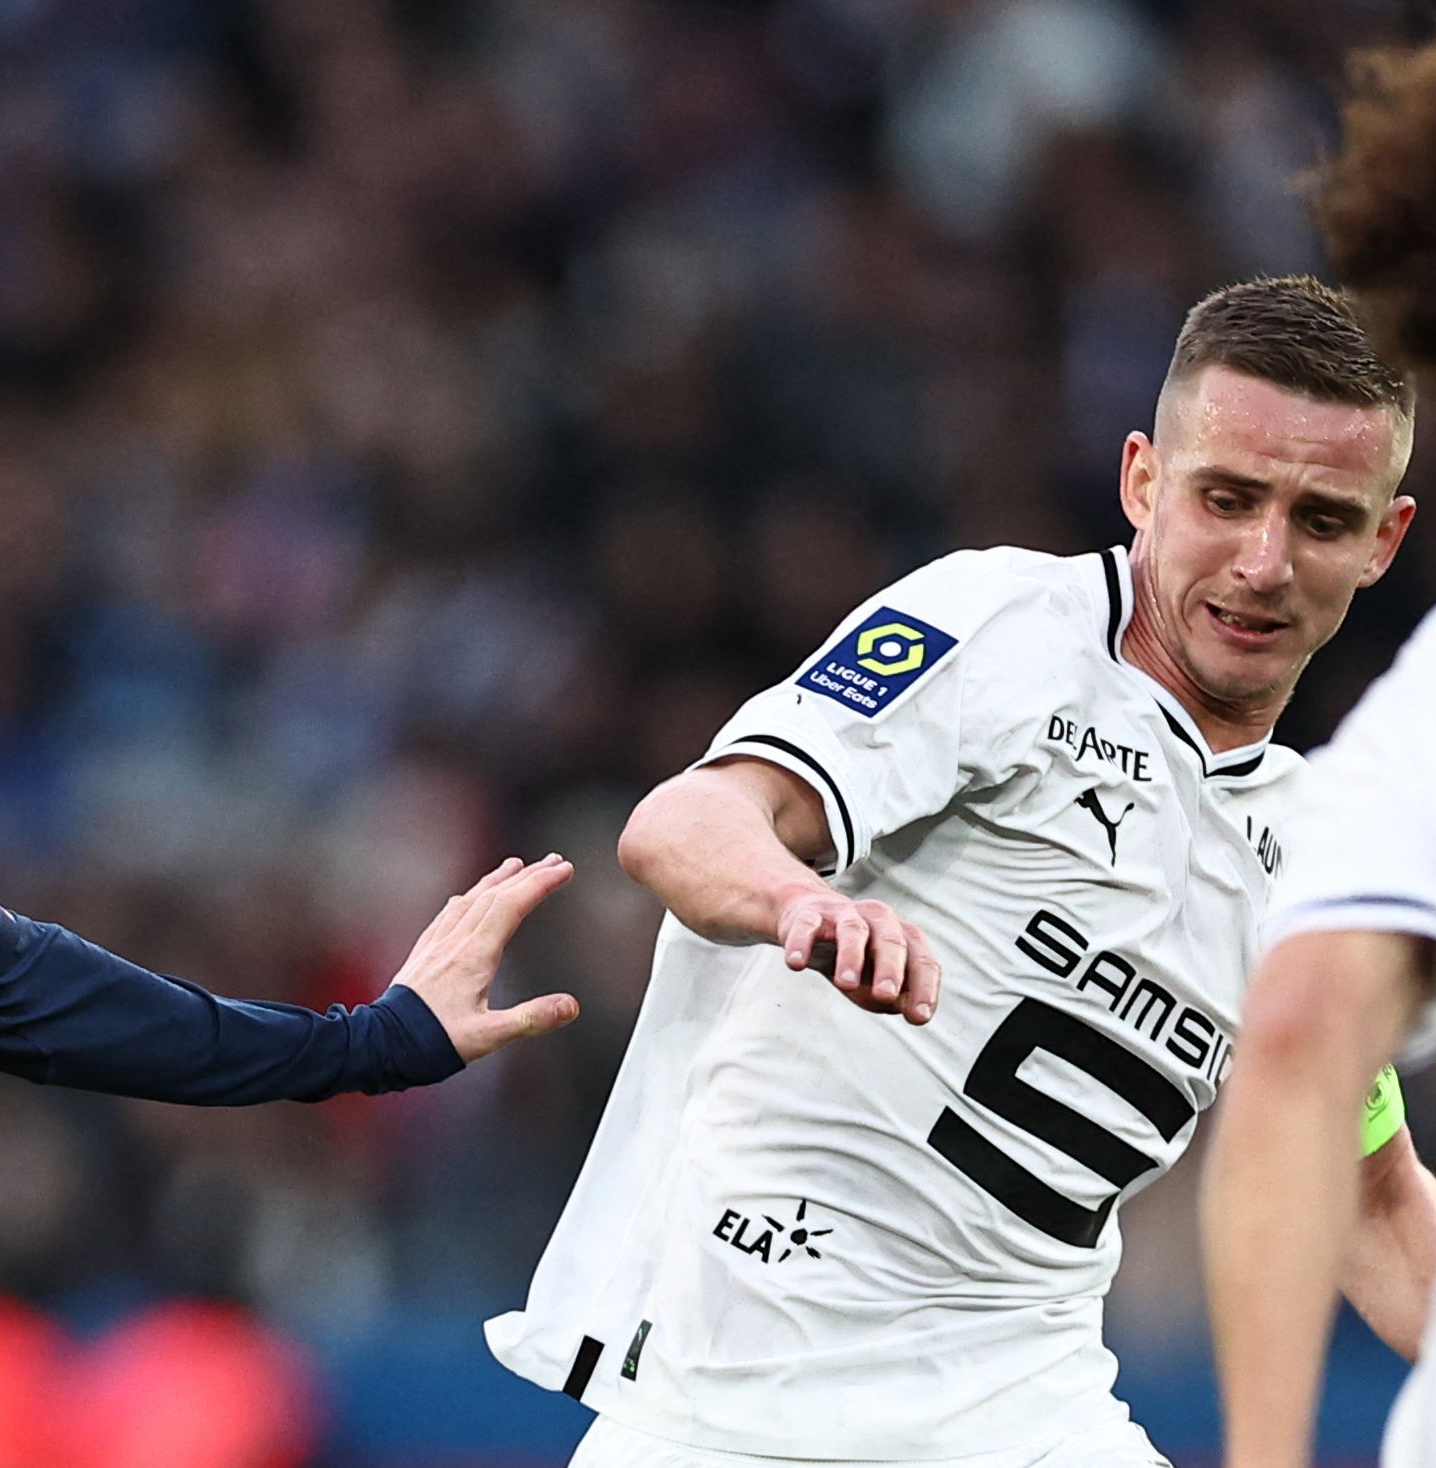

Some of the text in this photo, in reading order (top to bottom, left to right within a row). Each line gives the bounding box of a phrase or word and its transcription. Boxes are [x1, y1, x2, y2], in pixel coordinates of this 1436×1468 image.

[810, 671, 878, 709] Uber Eats
[826, 662, 888, 697] LIGUE 1
[712, 1208, 773, 1264] ELA
